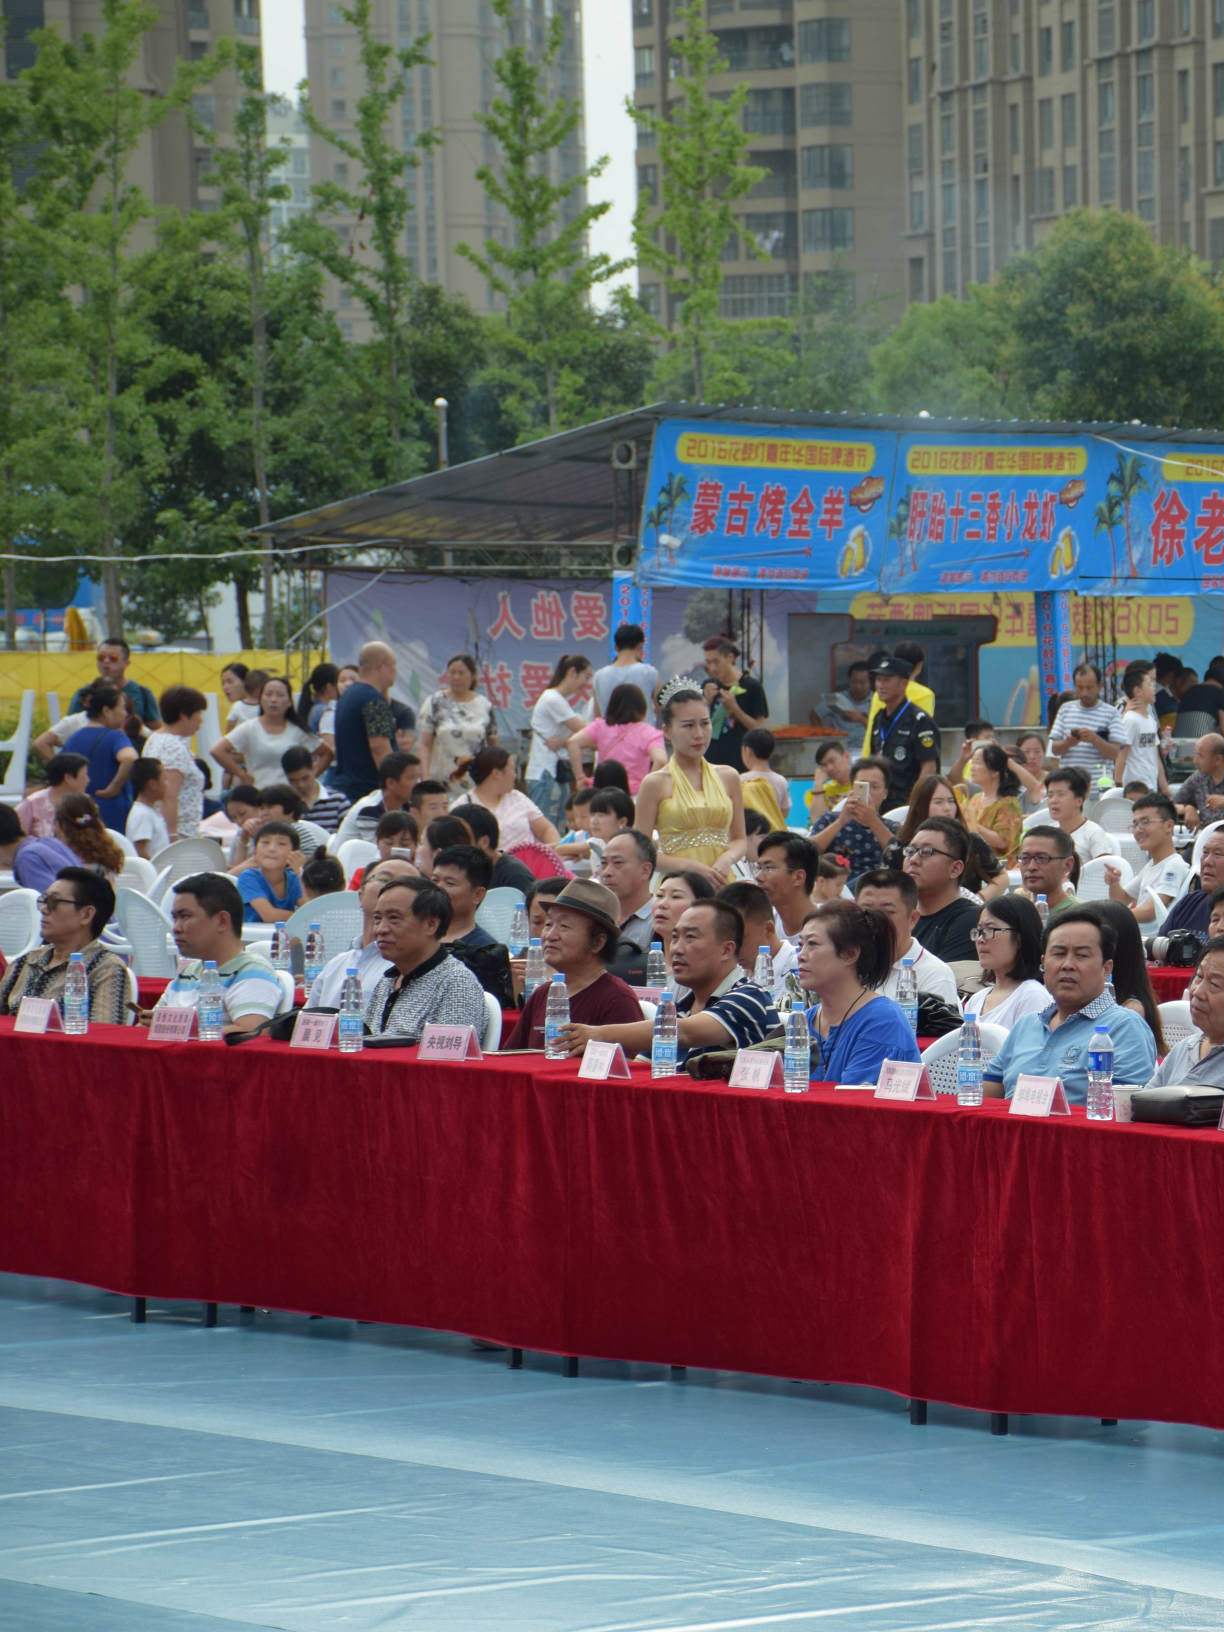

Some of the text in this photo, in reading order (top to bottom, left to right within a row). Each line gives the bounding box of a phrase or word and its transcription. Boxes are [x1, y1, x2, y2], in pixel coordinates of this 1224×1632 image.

[690, 480, 846, 540] 蒙古烤全羊
